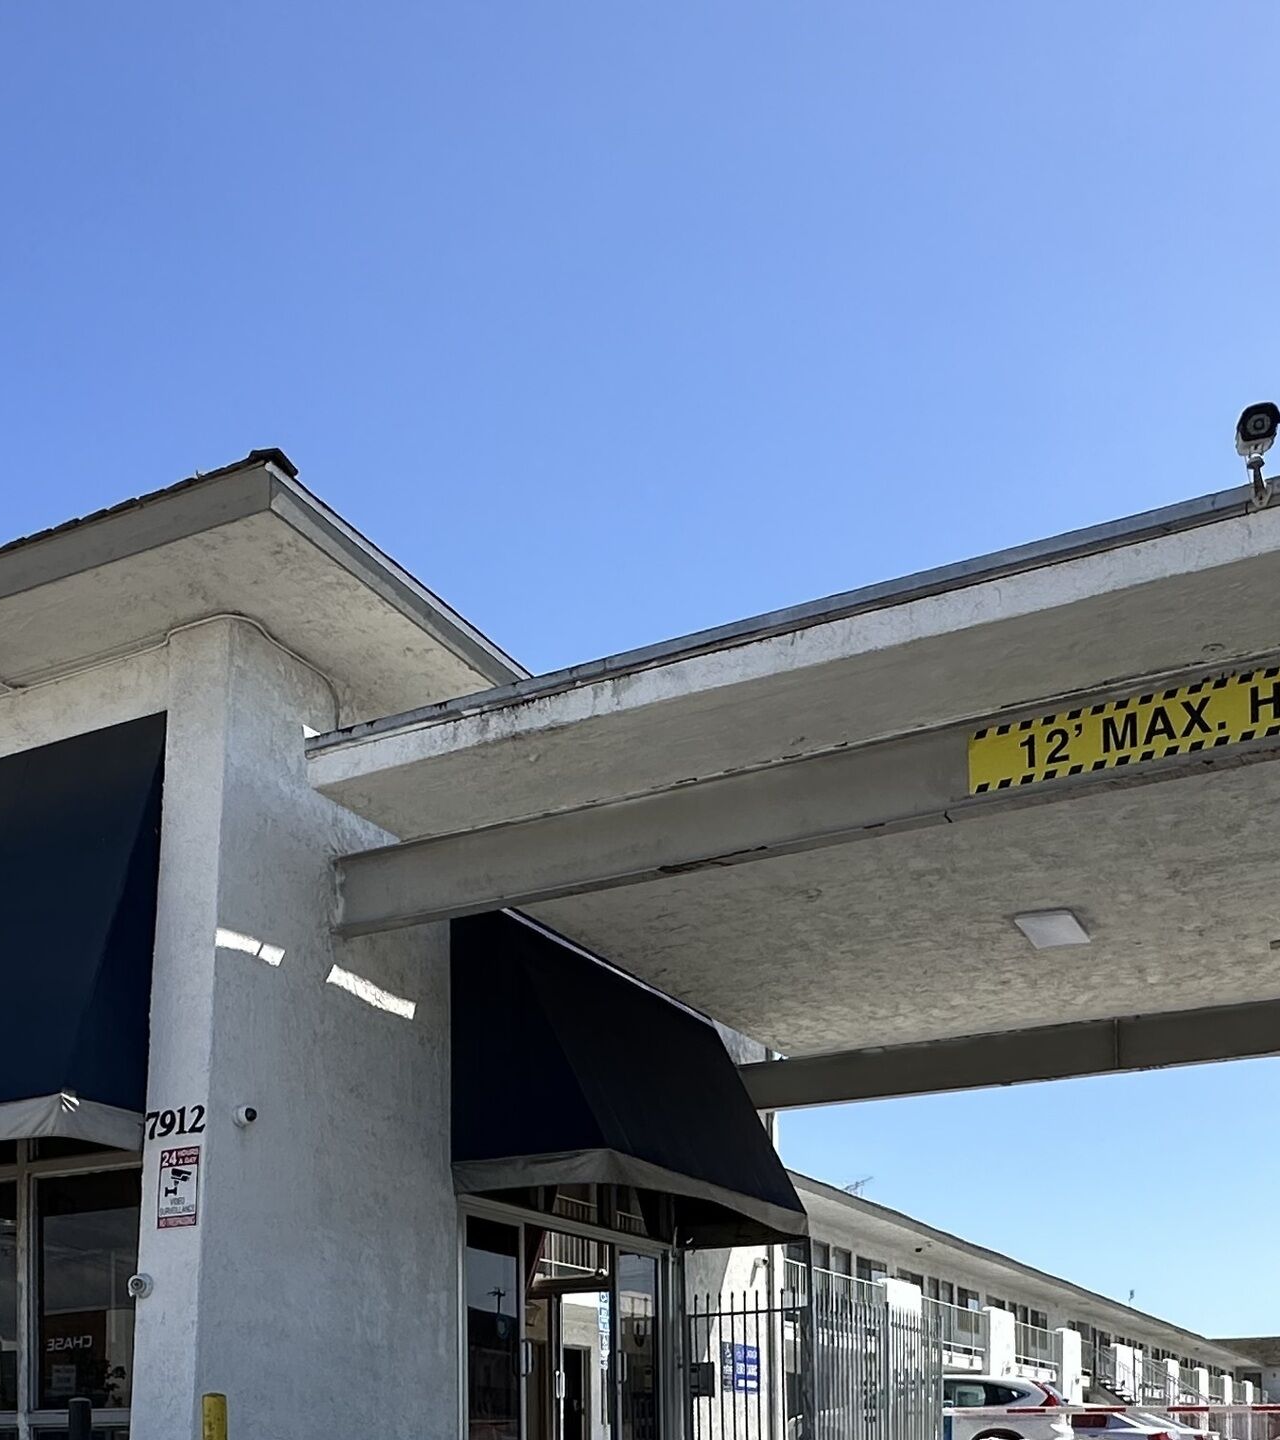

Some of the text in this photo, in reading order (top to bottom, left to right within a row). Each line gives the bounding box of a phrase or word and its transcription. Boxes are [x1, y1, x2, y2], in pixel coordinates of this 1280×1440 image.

[1102, 696, 1226, 753] MAX.
[145, 1104, 206, 1140] 7912
[162, 1147, 199, 1167] 24 HOURS
